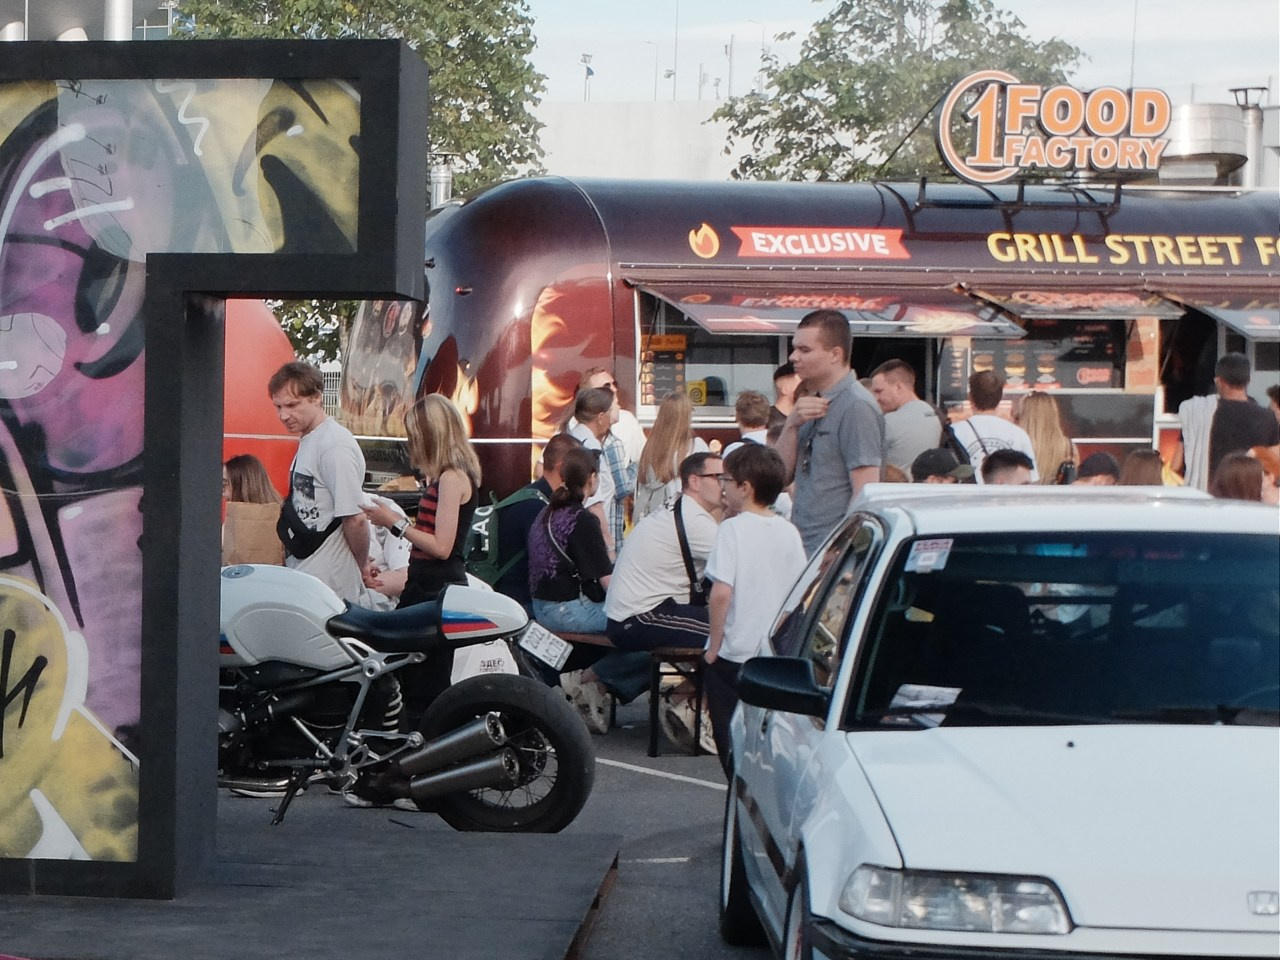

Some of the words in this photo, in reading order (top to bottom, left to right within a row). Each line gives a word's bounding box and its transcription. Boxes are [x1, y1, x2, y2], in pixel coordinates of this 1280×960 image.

[1005, 85, 1172, 137] FOOD
[1004, 135, 1168, 169] FACTORY
[751, 232, 890, 255] EXCLUSIVE
[986, 232, 1099, 264] GRILL
[1105, 234, 1244, 266] STREET
[1254, 236, 1280, 266] F
